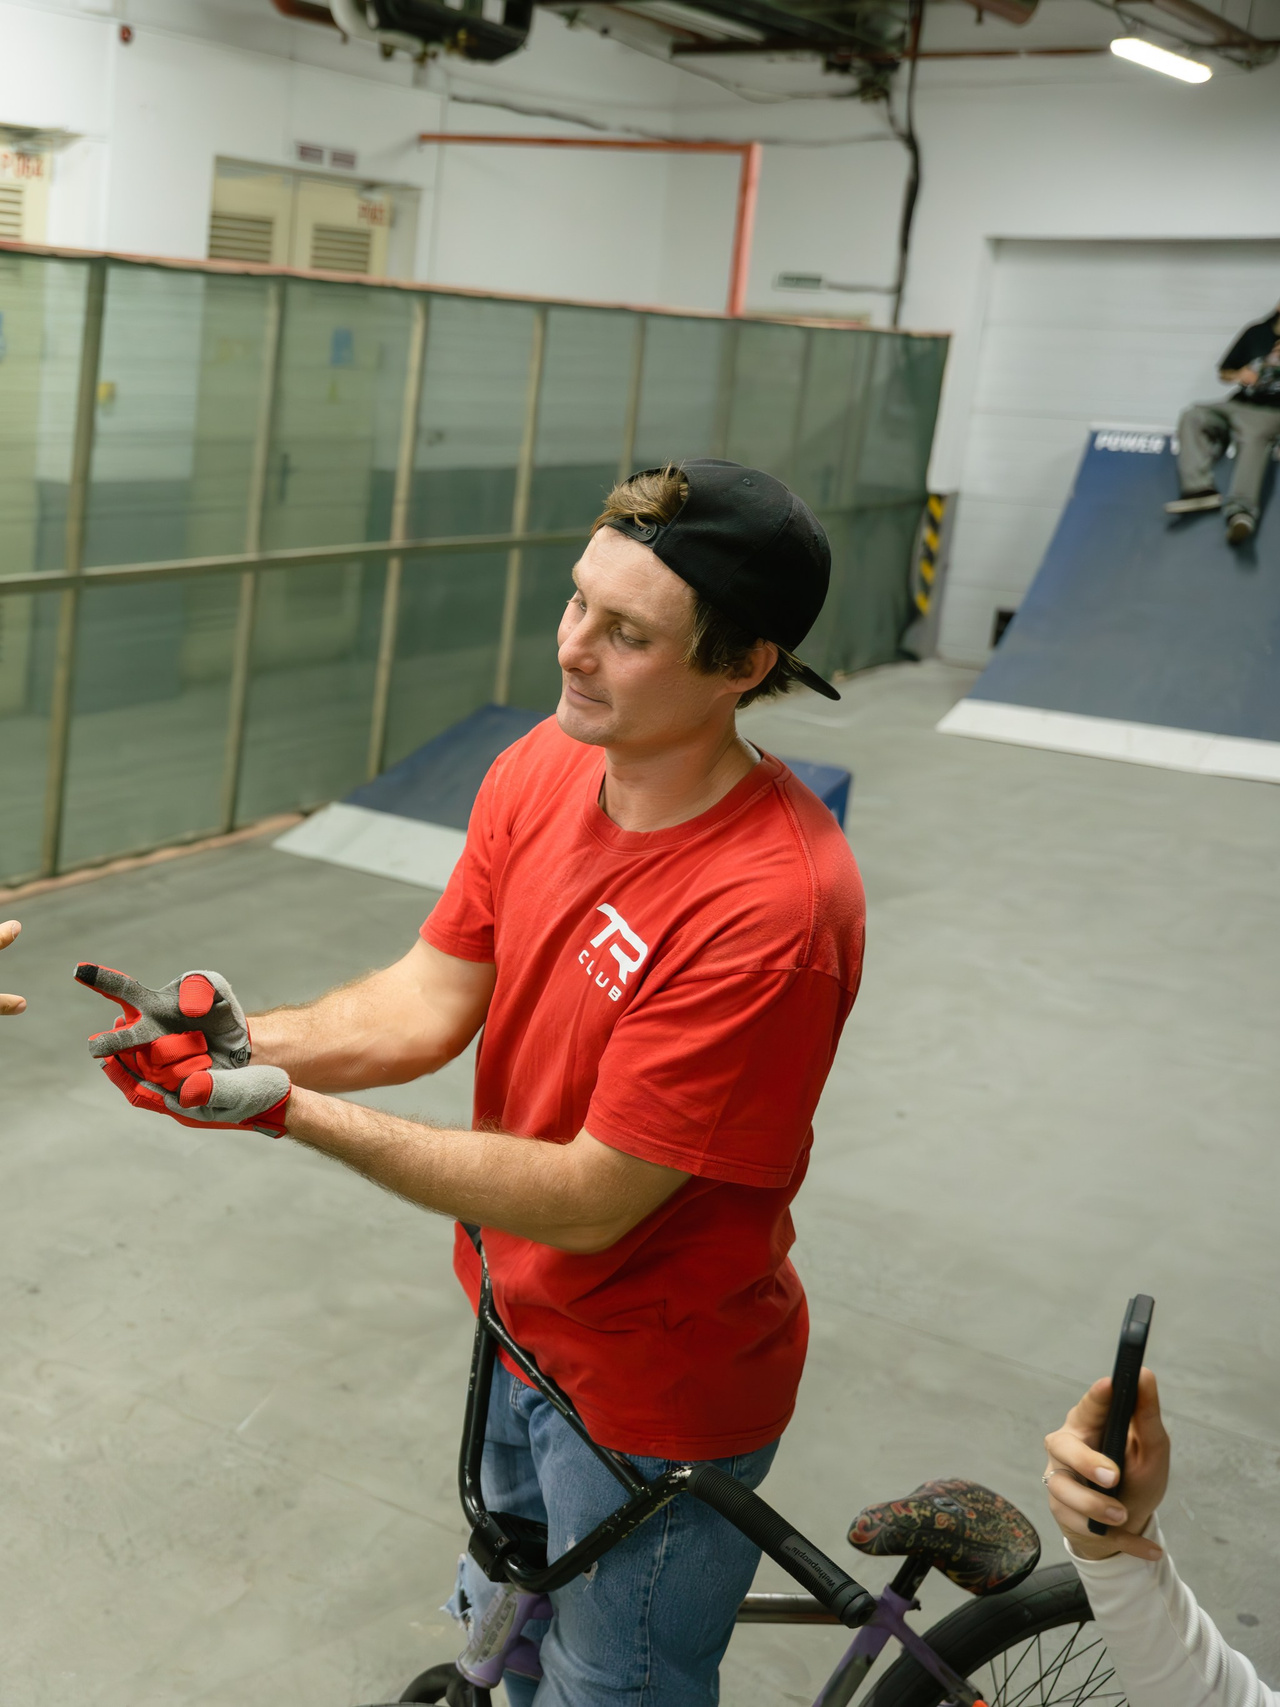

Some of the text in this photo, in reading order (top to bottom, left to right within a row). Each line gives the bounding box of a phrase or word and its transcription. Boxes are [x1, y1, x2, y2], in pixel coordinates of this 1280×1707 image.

[1094, 432, 1165, 454] POWER
[589, 902, 649, 985] TR
[577, 949, 622, 1002] CLUB
